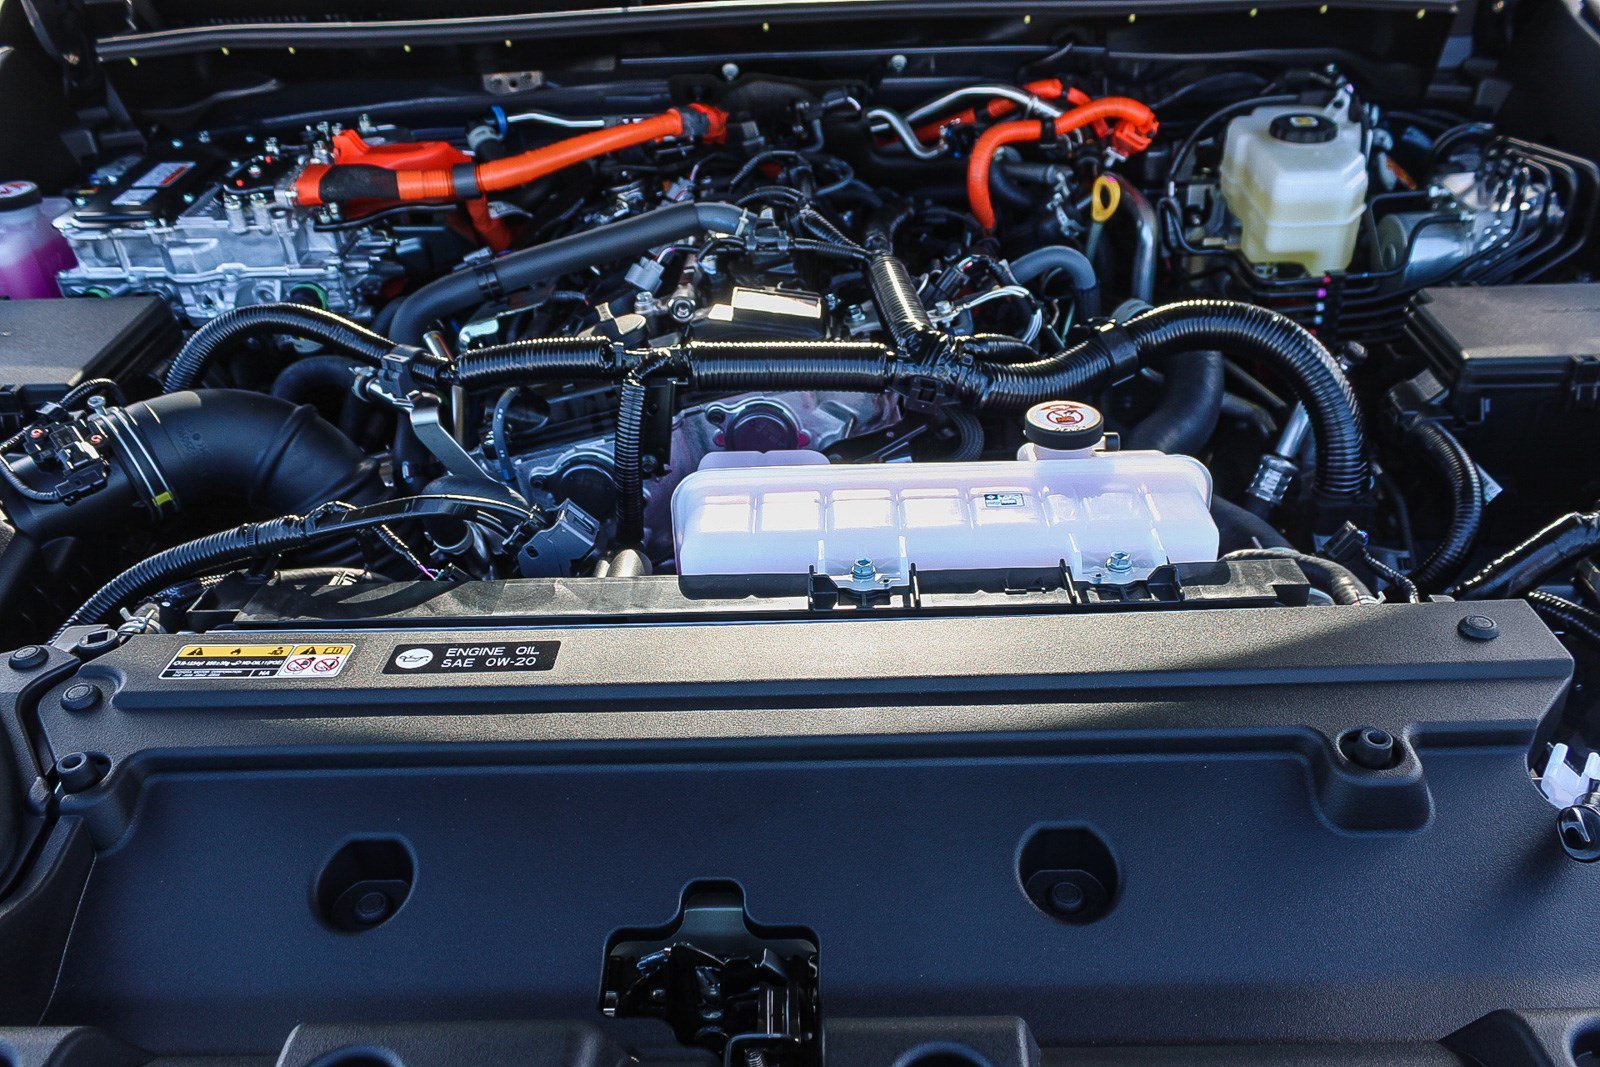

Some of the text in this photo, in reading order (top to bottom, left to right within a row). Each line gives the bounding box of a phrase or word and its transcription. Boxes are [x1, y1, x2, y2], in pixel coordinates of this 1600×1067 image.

[445, 646, 540, 656] ENGINE OIL
[441, 657, 535, 668] SAE 0W-20
